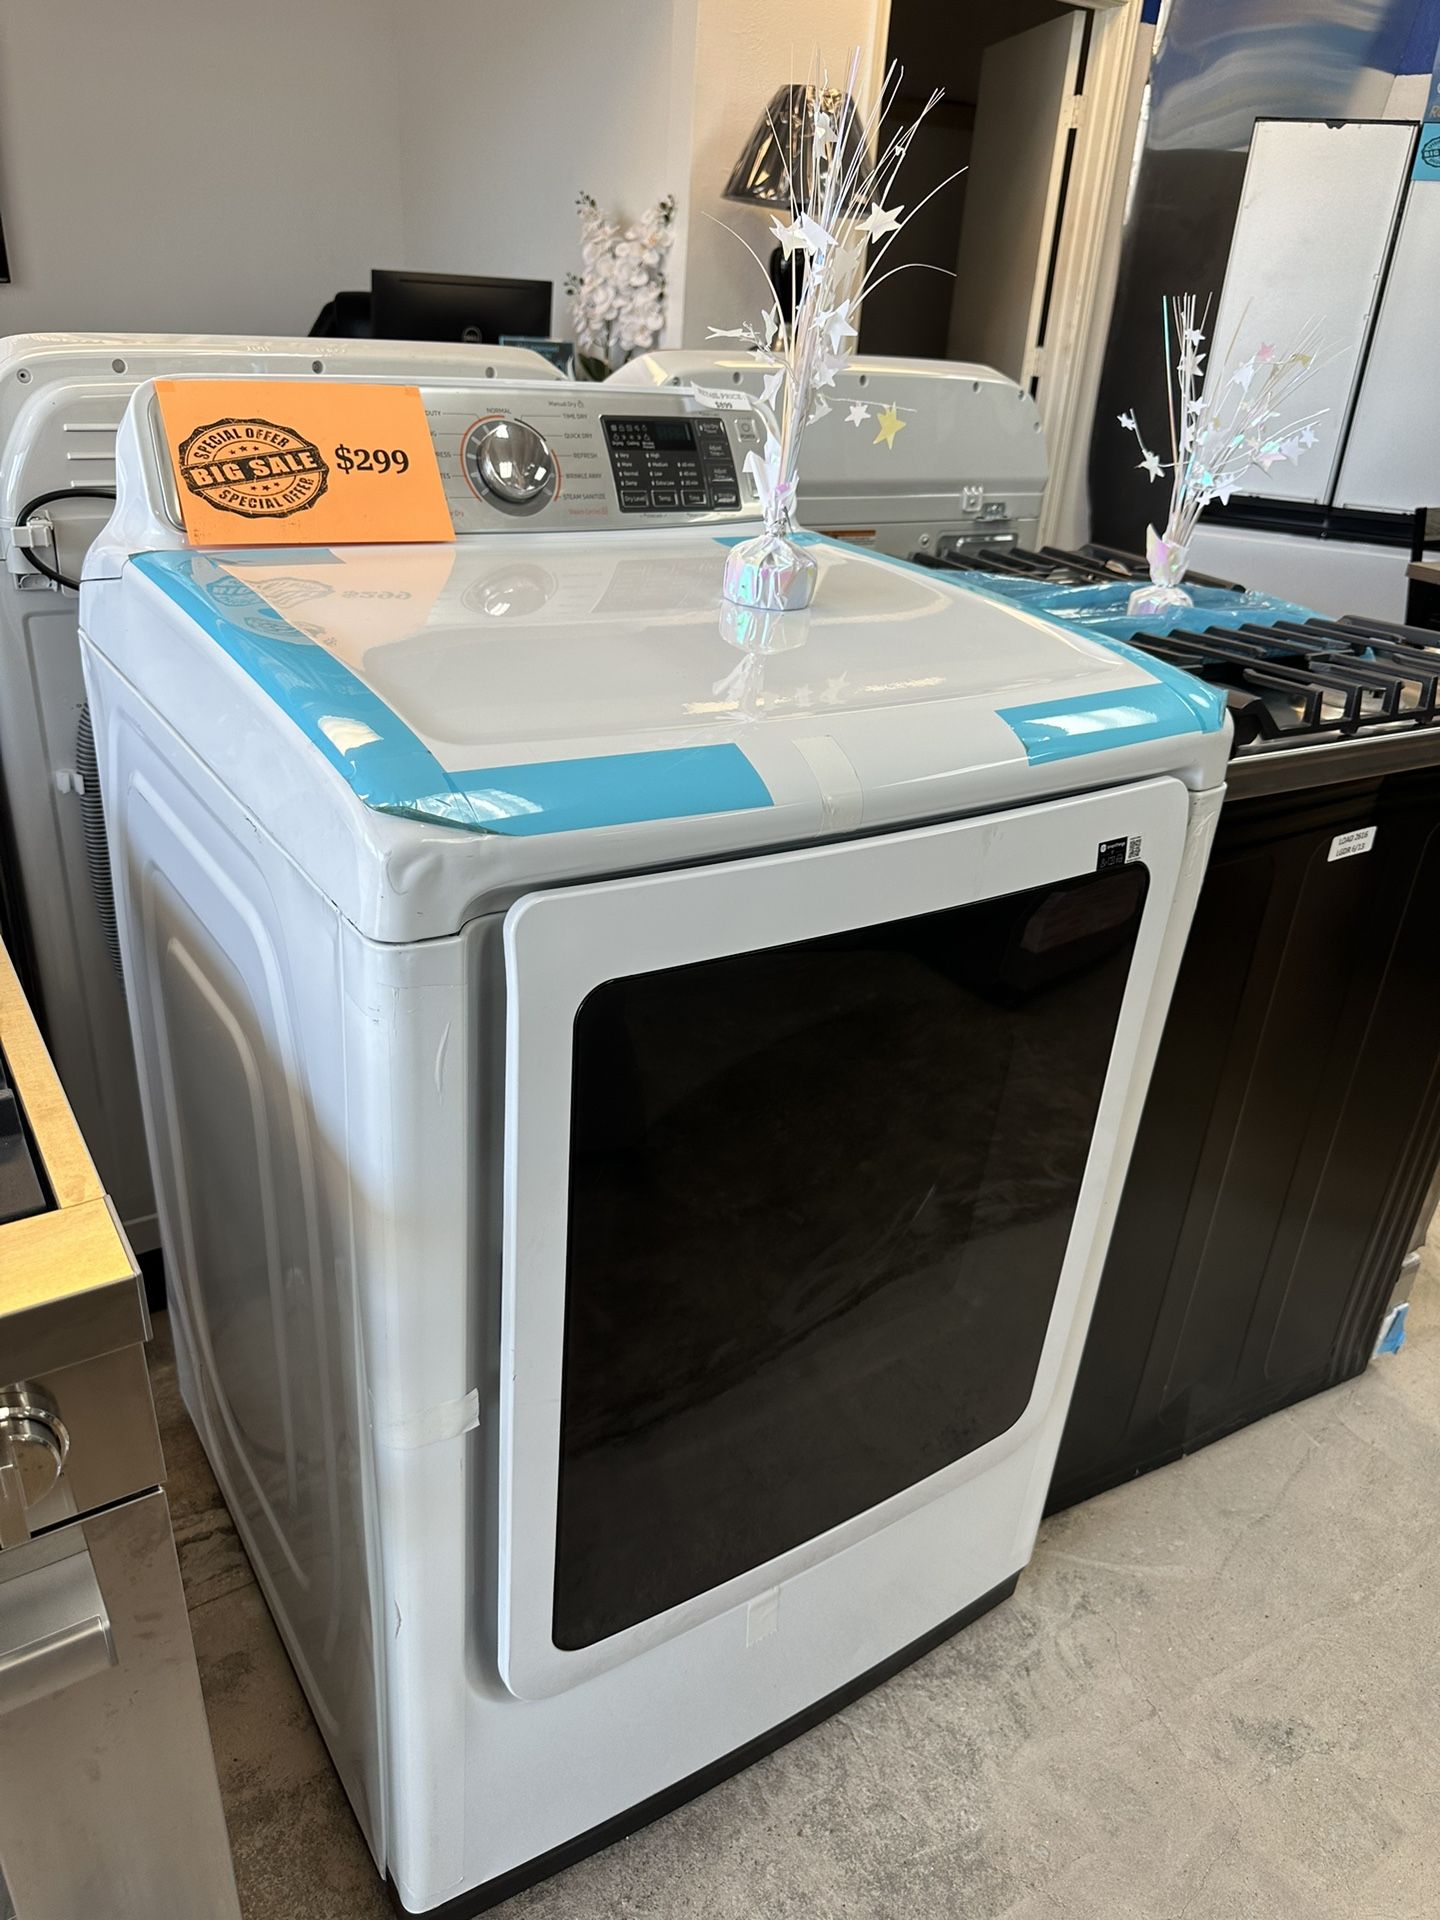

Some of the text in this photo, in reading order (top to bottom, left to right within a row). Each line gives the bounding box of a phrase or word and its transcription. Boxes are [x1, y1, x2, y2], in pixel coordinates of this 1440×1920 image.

[194, 428, 289, 460] SPECIAL OFFER
[334, 443, 410, 475] $299
[189, 451, 318, 486] BIG SALE
[218, 476, 315, 509] SPECIAL OFFER
